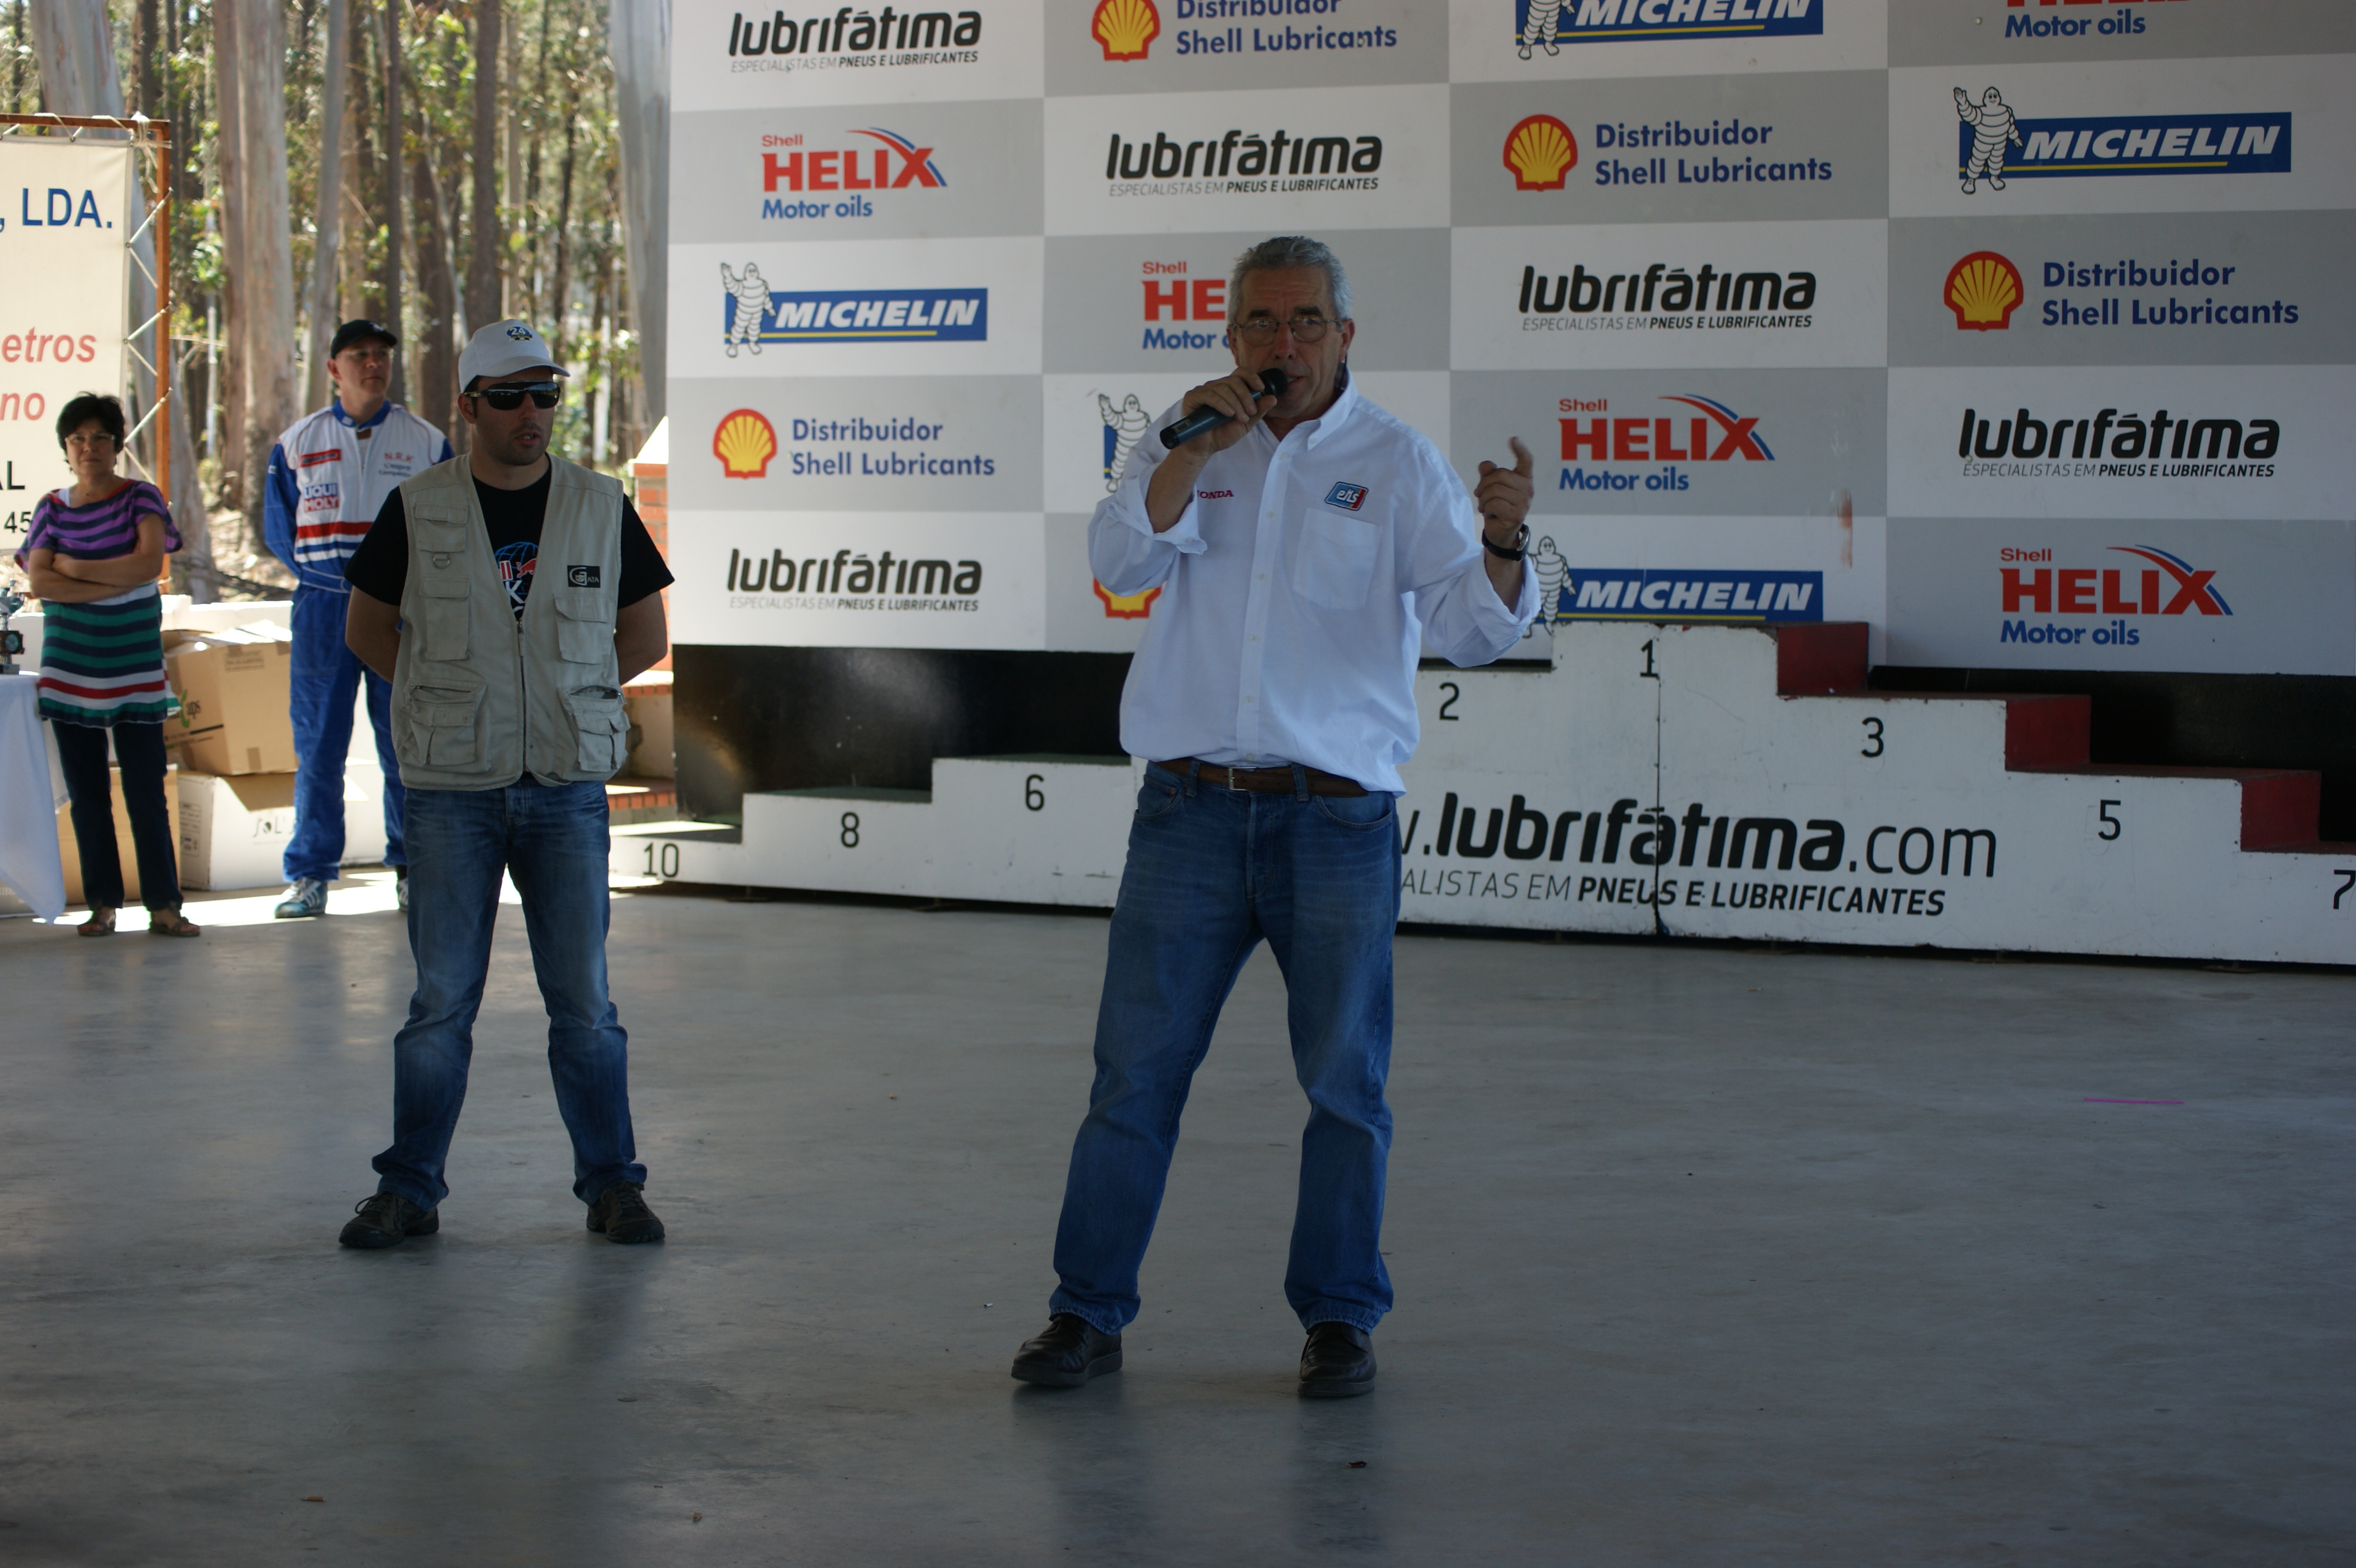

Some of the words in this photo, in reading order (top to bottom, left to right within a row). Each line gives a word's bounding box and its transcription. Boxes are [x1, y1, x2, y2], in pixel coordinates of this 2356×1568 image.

[1576, 0, 1812, 26] MICHELIN
[2005, 14, 2091, 37] Motor
[2097, 9, 2146, 34] oils
[729, 7, 981, 56] lubrifátima
[1177, 28, 1242, 54] Shell
[1254, 25, 1397, 51] Lubricants
[731, 58, 817, 73] ESPECIALISTAS
[819, 57, 836, 70] EM
[838, 55, 876, 68] PNEUS
[880, 54, 886, 66] E
[890, 51, 978, 66] LUBRIFICANTES
[762, 134, 803, 147] Shell
[1596, 119, 1773, 148] Distribuidor
[2023, 126, 2281, 160] MICHELIN
[761, 147, 940, 192] HELIX
[1106, 130, 1382, 180] lubrifátima
[1596, 159, 1665, 185] Shell
[1678, 157, 1832, 183] Lubricants
[1109, 182, 1202, 197] ESPECIALISTAS
[1205, 182, 1224, 194] EM
[1226, 181, 1267, 193] PNEUS
[1271, 180, 1278, 192] E
[1281, 178, 1378, 192] LUBRIFICANTES
[22, 188, 112, 228] LDA.
[762, 197, 830, 219] Motor
[835, 195, 872, 217] oils
[1143, 261, 1187, 274] Shell
[2043, 259, 2235, 288] Distribuidor
[1519, 264, 1816, 313] lubrifátima
[775, 300, 979, 328] MICHELIN
[1522, 317, 1623, 331] ESPECIALISTAS
[1626, 318, 1647, 330] EM
[1650, 316, 1693, 329] PNEUS
[1697, 317, 1705, 328] E
[1708, 315, 1812, 328] LUBRIFICANTES
[2043, 299, 2119, 326] Shell
[2132, 299, 2299, 325] Lubricants
[1143, 328, 1216, 349] Motor
[1559, 398, 1607, 412] Shell
[793, 418, 943, 441] Distribuidor
[1558, 418, 1766, 461] HELIX
[1959, 408, 2280, 459] lubrifátima
[792, 452, 852, 476] Shell
[862, 453, 995, 476] Lubricants
[1963, 463, 2071, 477] ESPECIALISTAS
[2074, 464, 2095, 477] EM
[2099, 464, 2146, 477] PNEUS
[2150, 464, 2158, 477] E
[2162, 464, 2274, 478] LUBRIFICANTES
[1559, 468, 1640, 491] Motor
[1645, 467, 1689, 491] oils
[2000, 548, 2052, 562] Shell
[728, 548, 982, 595] lubrifátima
[730, 597, 815, 610] ESPECIALISTAS
[818, 598, 835, 610] EM
[837, 599, 875, 610] PNEUS
[878, 599, 885, 610] E
[888, 599, 979, 612] LUBRIFICANTES
[1576, 580, 1813, 611] MICHELIN
[1999, 569, 2224, 616] HELIX
[2000, 620, 2086, 645] Motor
[2092, 620, 2140, 646] oils
[1640, 639, 1659, 678] 1
[1439, 682, 1459, 721] 2
[1861, 717, 1884, 757] 3
[1025, 774, 1045, 812] 6
[840, 812, 860, 849] 8
[2098, 799, 2122, 840] 5
[642, 842, 680, 878] 10
[1401, 869, 1519, 898] ALISTAS
[1527, 874, 1571, 901] EM
[1578, 876, 1678, 905] PNEUS
[1686, 880, 1704, 907] E
[1711, 882, 1945, 916] LUBRIFICANTES
[2333, 869, 2356, 910] 7
